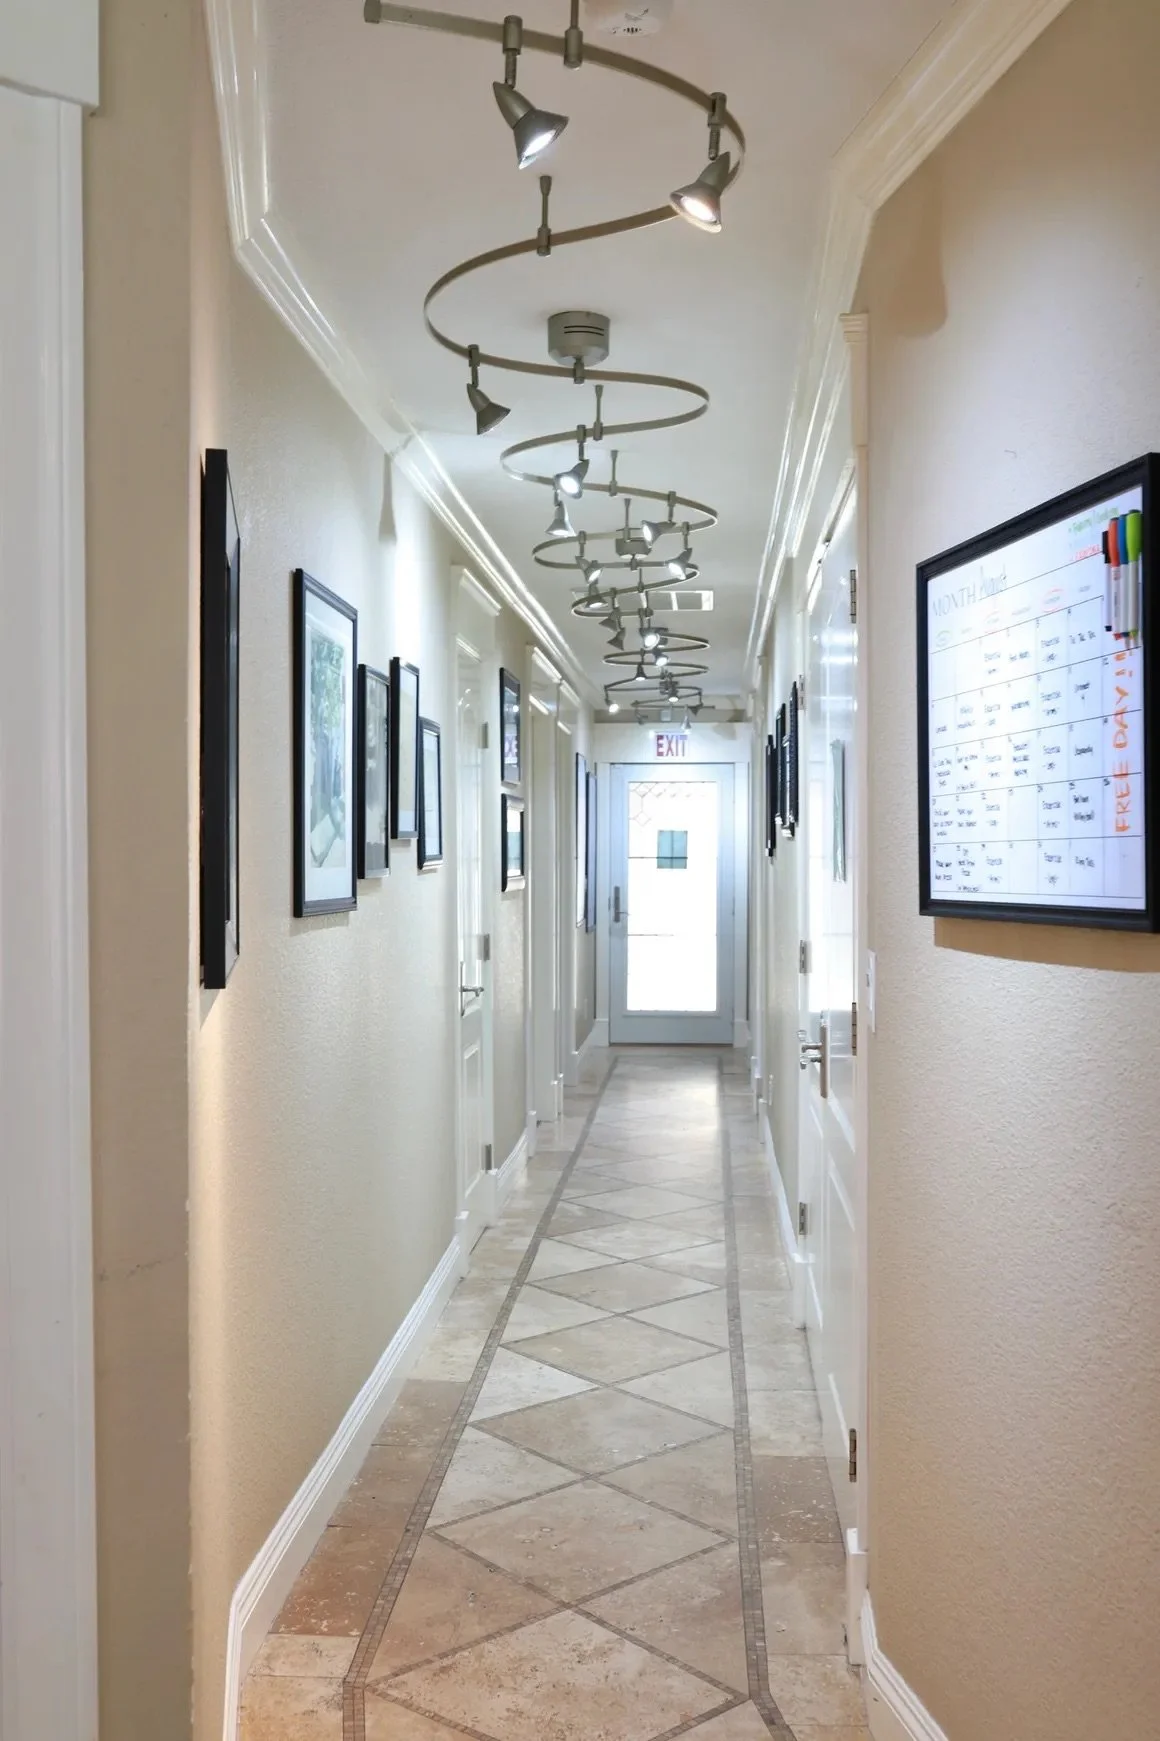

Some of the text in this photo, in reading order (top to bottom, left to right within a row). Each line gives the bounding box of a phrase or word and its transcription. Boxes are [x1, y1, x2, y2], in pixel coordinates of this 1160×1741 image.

[932, 583, 976, 617] MONTH
[656, 734, 688, 757] EXIT
[1113, 760, 1132, 832] FREE
